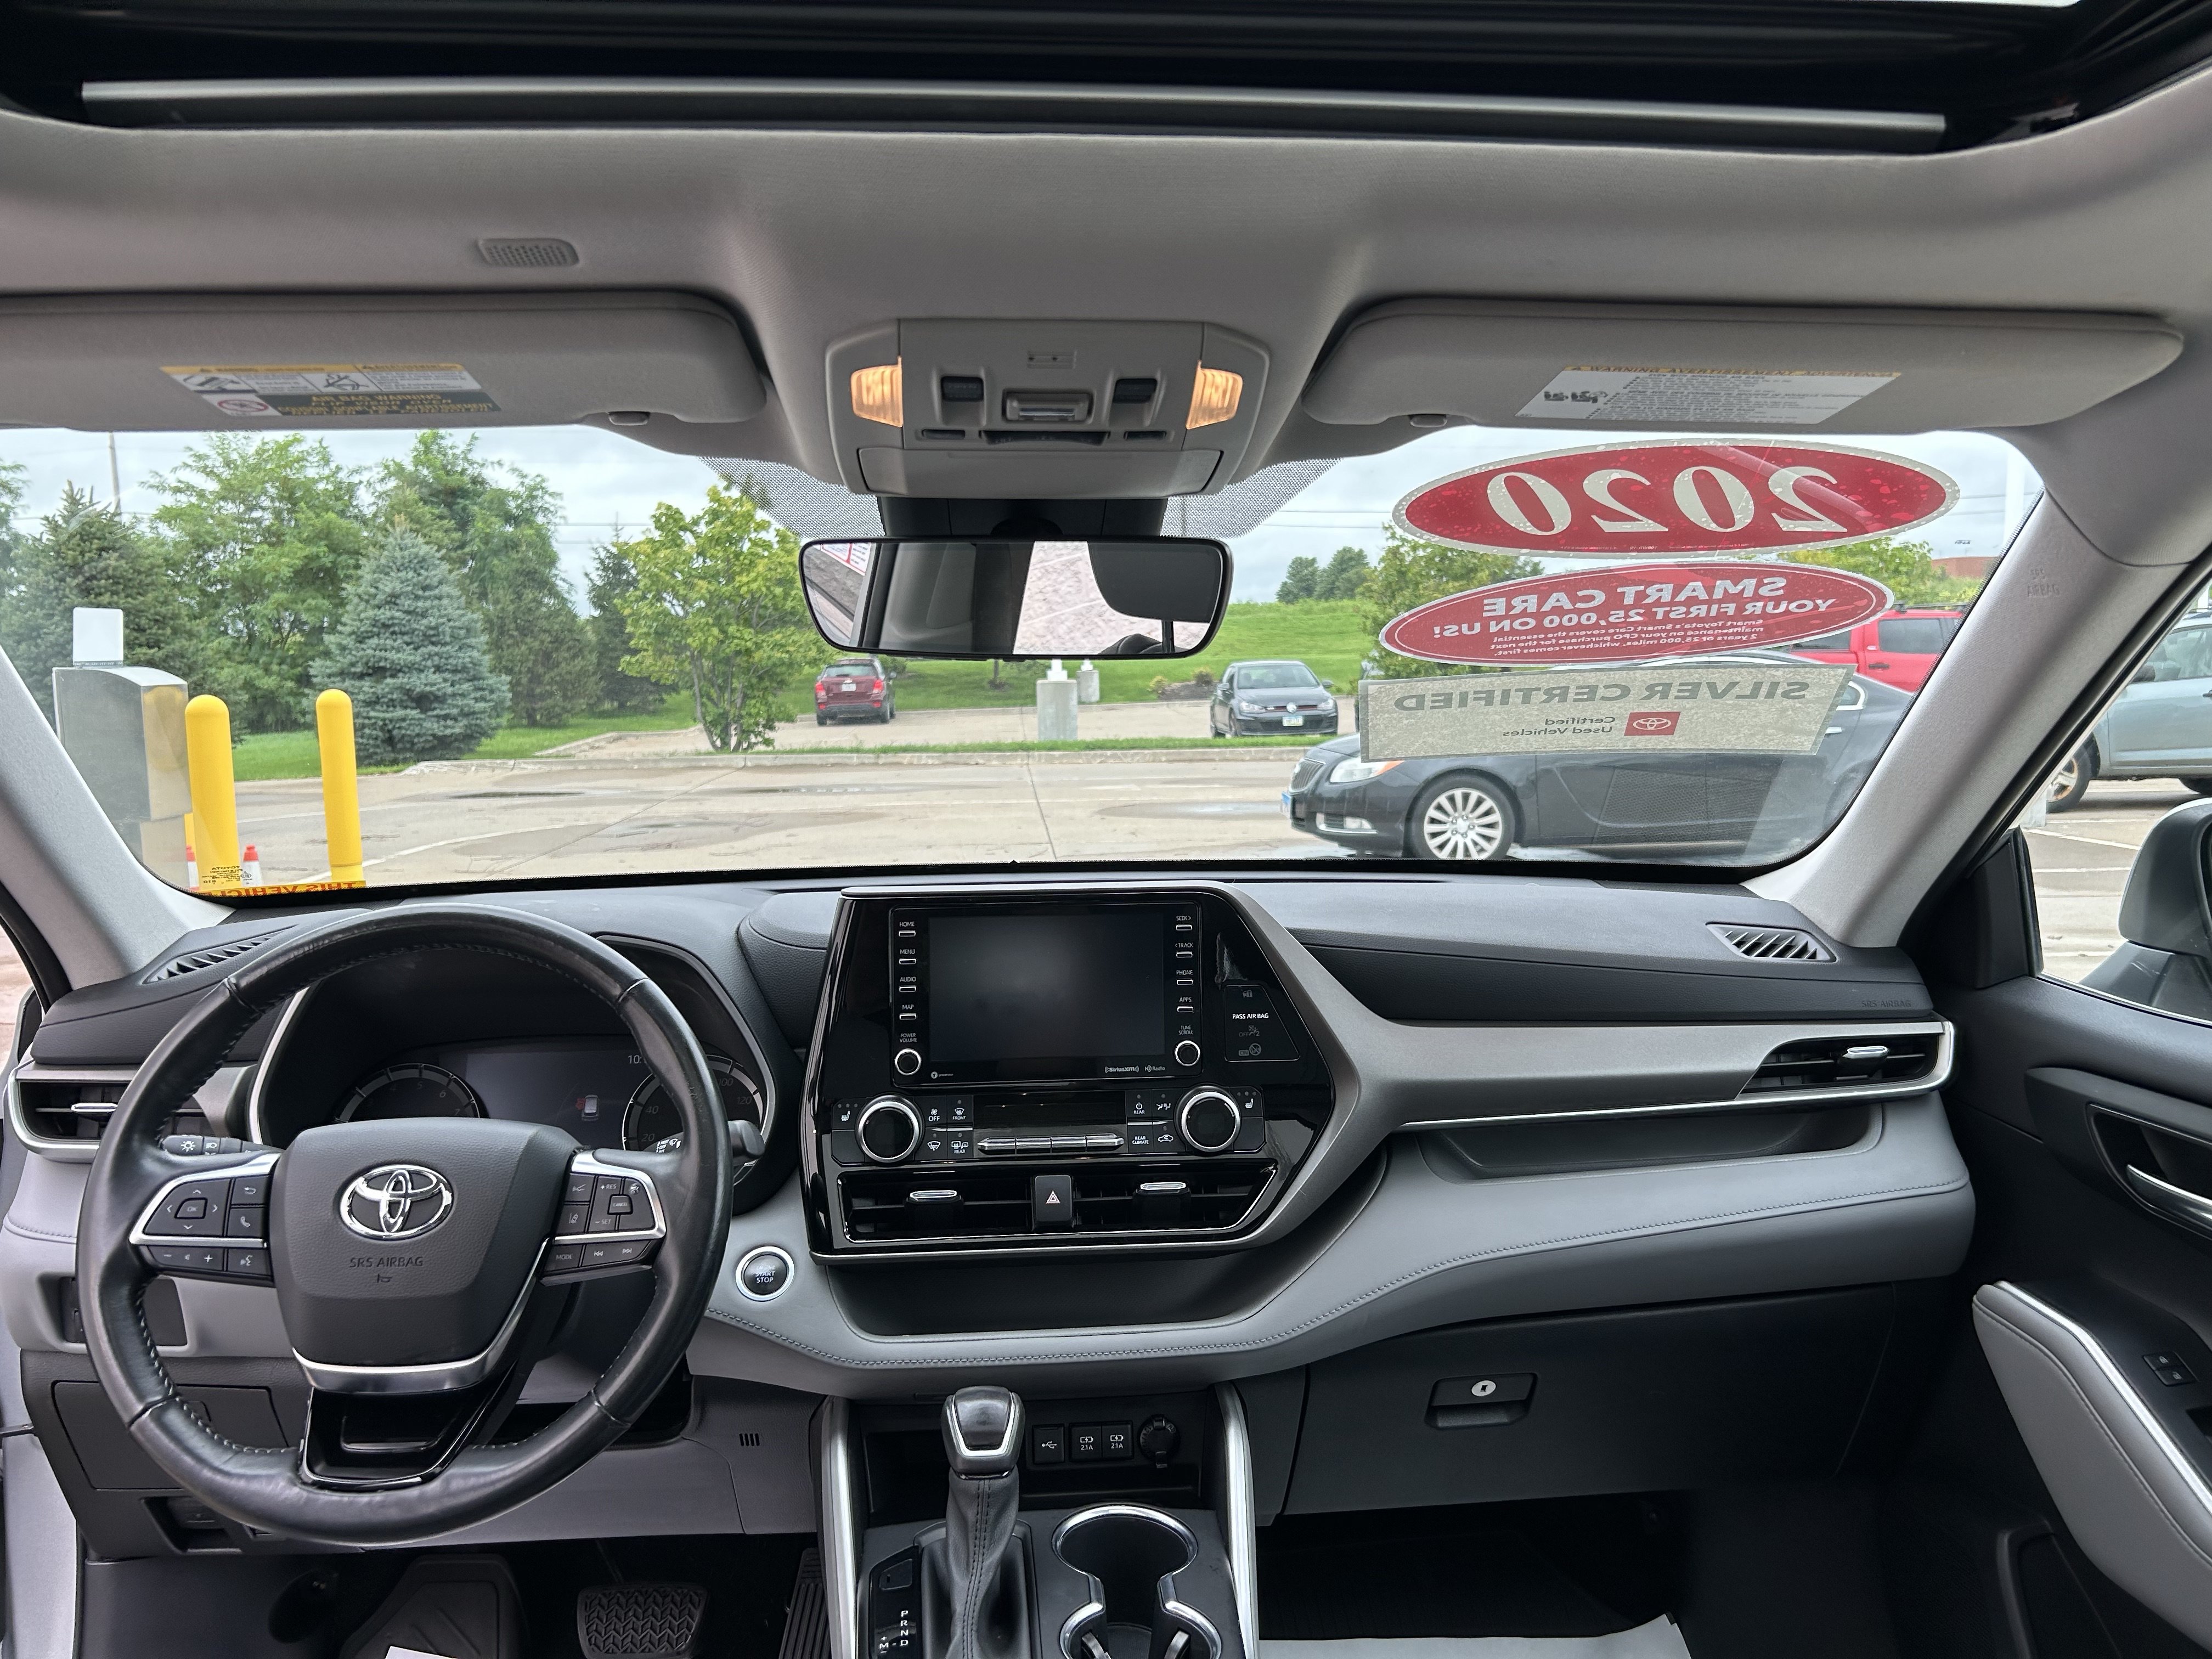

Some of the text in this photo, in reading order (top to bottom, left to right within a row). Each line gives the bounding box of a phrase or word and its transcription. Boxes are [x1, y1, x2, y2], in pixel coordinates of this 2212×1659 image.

[439, 1090, 446, 1098] 6
[645, 1105, 659, 1114] 40
[641, 1133, 655, 1142] 20
[349, 1256, 424, 1268] SRS AIRBAG
[901, 1610, 909, 1618] P
